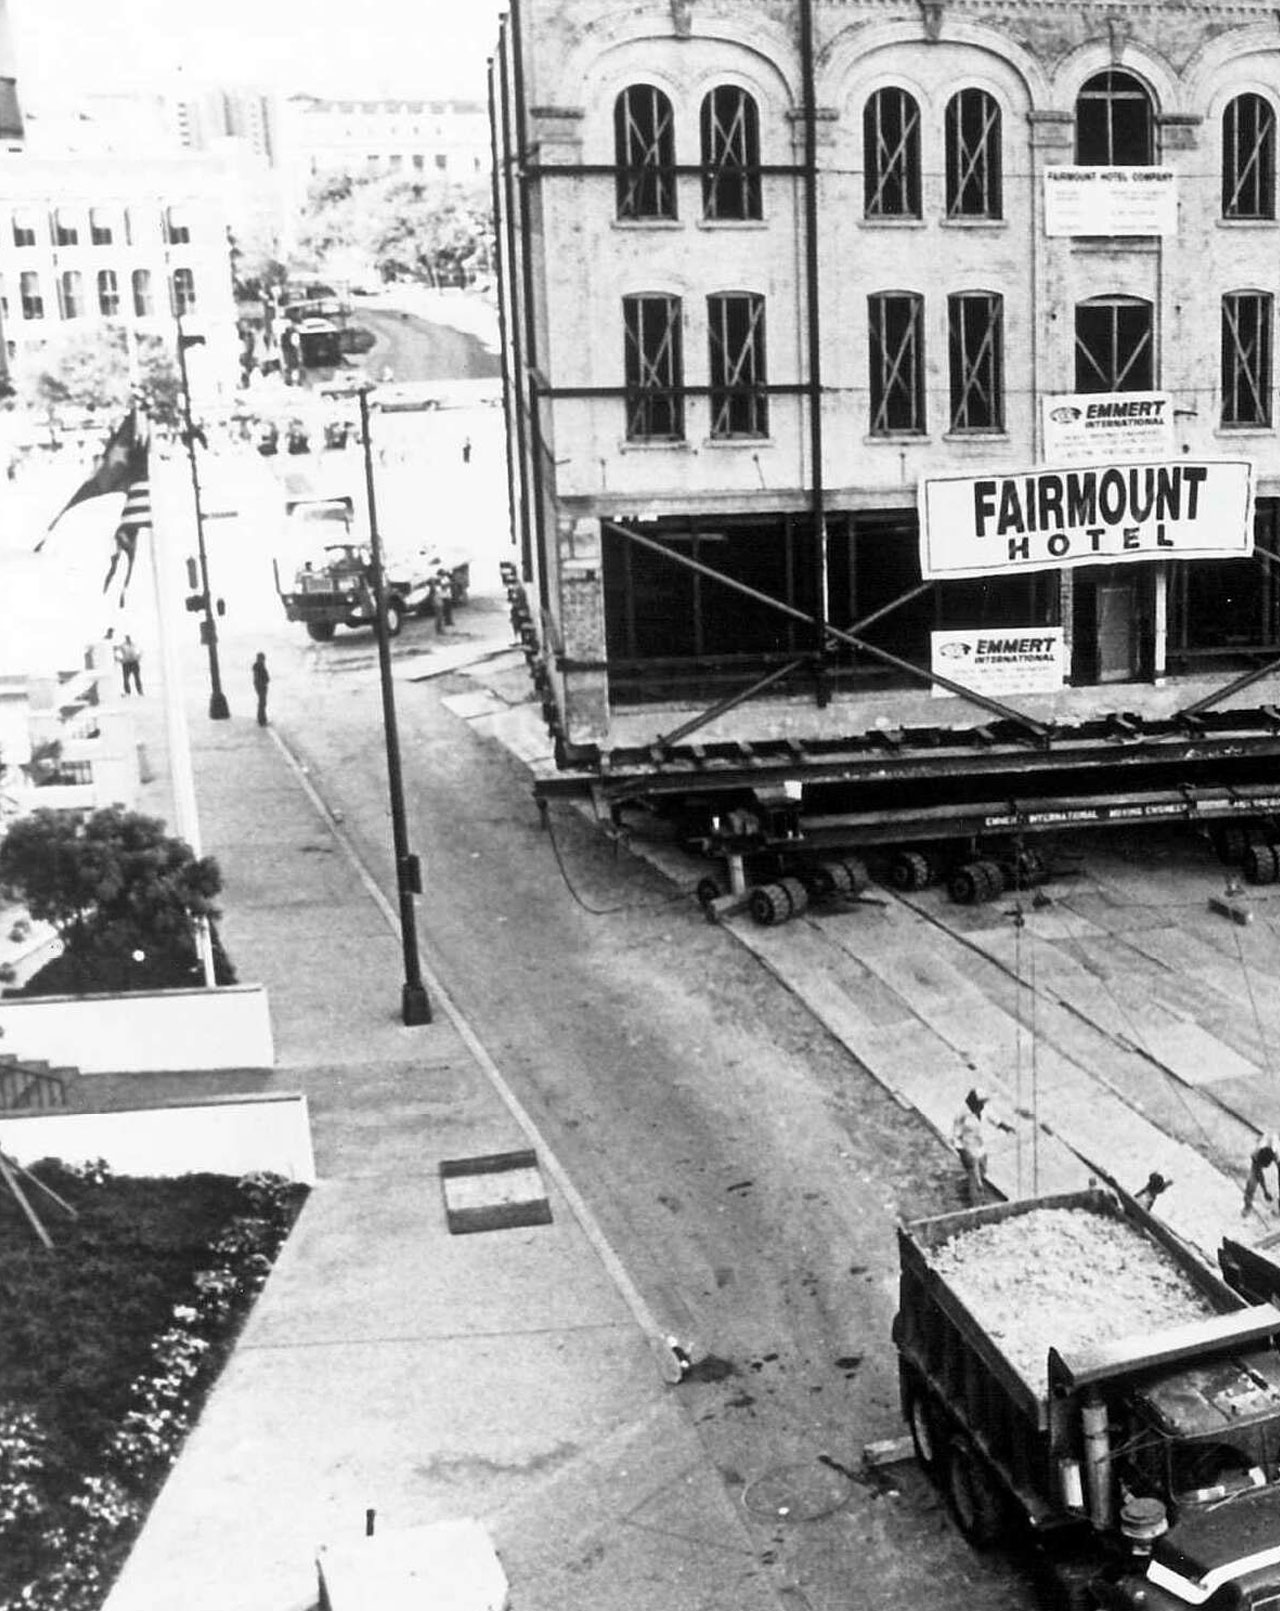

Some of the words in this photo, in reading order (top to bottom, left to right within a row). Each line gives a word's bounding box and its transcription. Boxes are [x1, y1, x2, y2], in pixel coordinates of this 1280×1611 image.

[1086, 401, 1166, 419] EMMERT
[1085, 418, 1165, 428] INTERNATIONAL
[974, 467, 1207, 537] FAIRMOUNT
[1008, 524, 1174, 560] HOTEL
[976, 638, 1056, 654] EMMERT
[975, 654, 1055, 664] INTERNATIONAL
[985, 812, 1021, 826] EMMER
[1029, 810, 1099, 823] INTERNATIONAL
